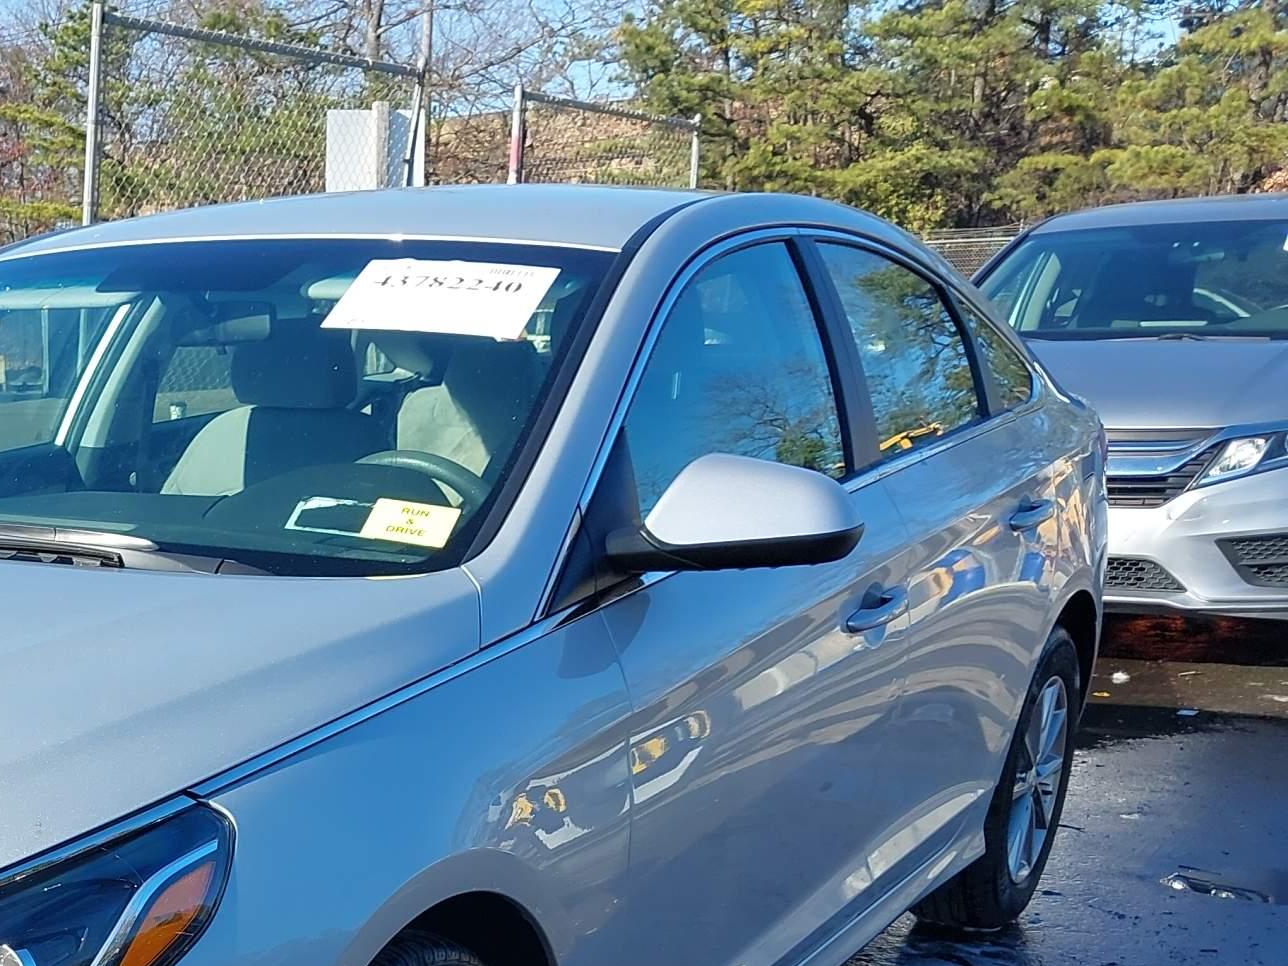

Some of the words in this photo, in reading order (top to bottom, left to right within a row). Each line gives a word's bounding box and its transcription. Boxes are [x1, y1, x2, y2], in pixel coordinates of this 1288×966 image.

[374, 275, 523, 293] 43782240
[401, 507, 430, 517] RUN
[385, 525, 425, 536] DRIVE
